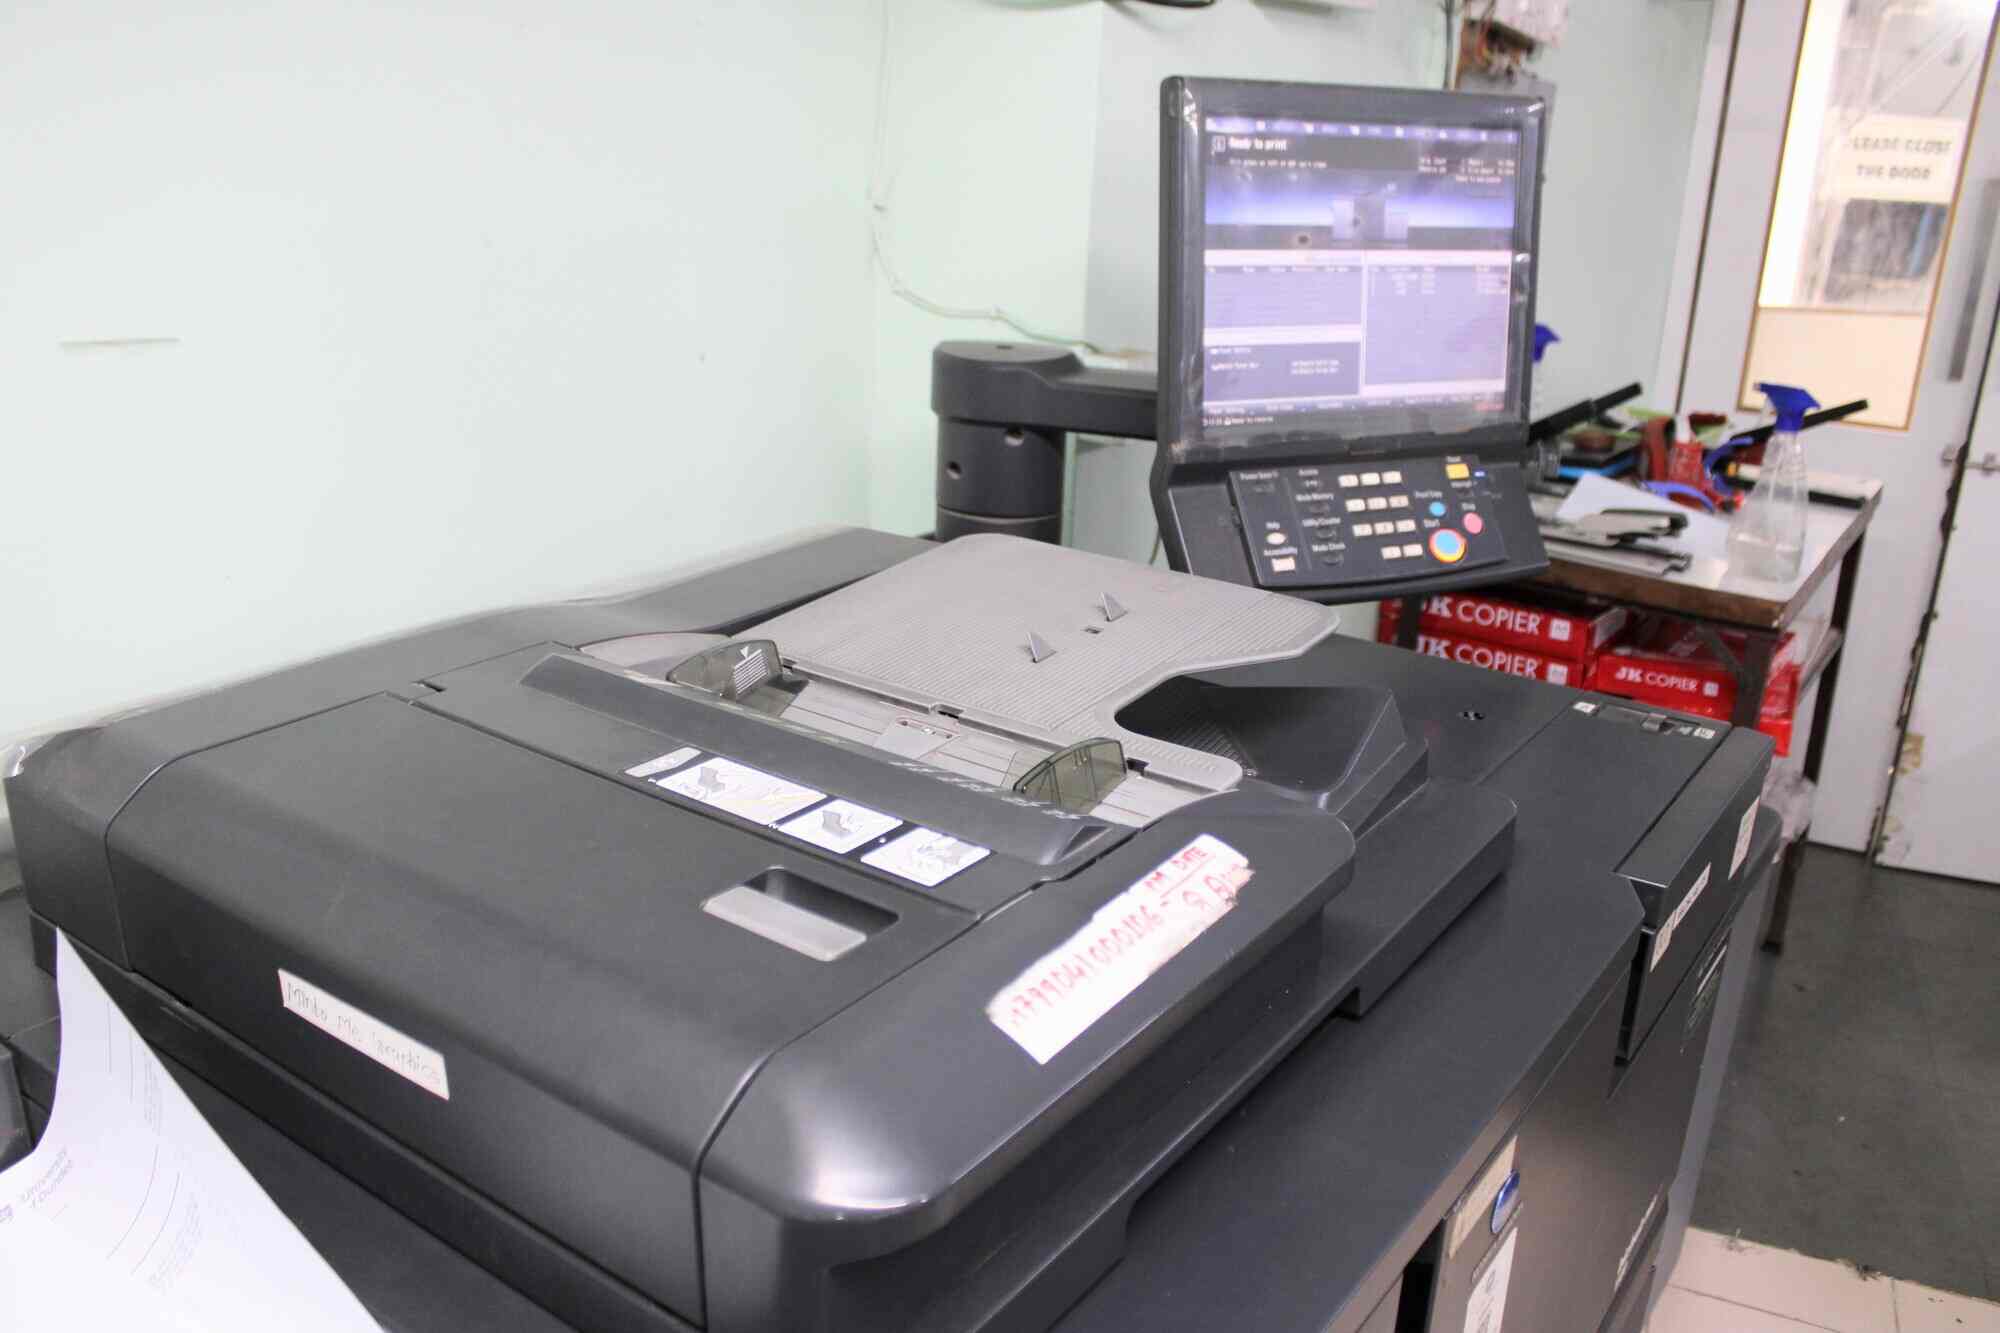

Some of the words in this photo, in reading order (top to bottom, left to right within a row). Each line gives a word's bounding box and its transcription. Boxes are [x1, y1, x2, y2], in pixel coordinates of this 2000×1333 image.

[1264, 138, 1287, 151] print
[1904, 139, 1952, 154] CLOSE
[1856, 163, 1884, 177] THE
[1889, 165, 1931, 180] DOOR
[1456, 600, 1541, 635] COPIER
[1455, 643, 1538, 680] COPIER
[1615, 666, 1643, 683] JK
[1645, 671, 1699, 693] COPIER
